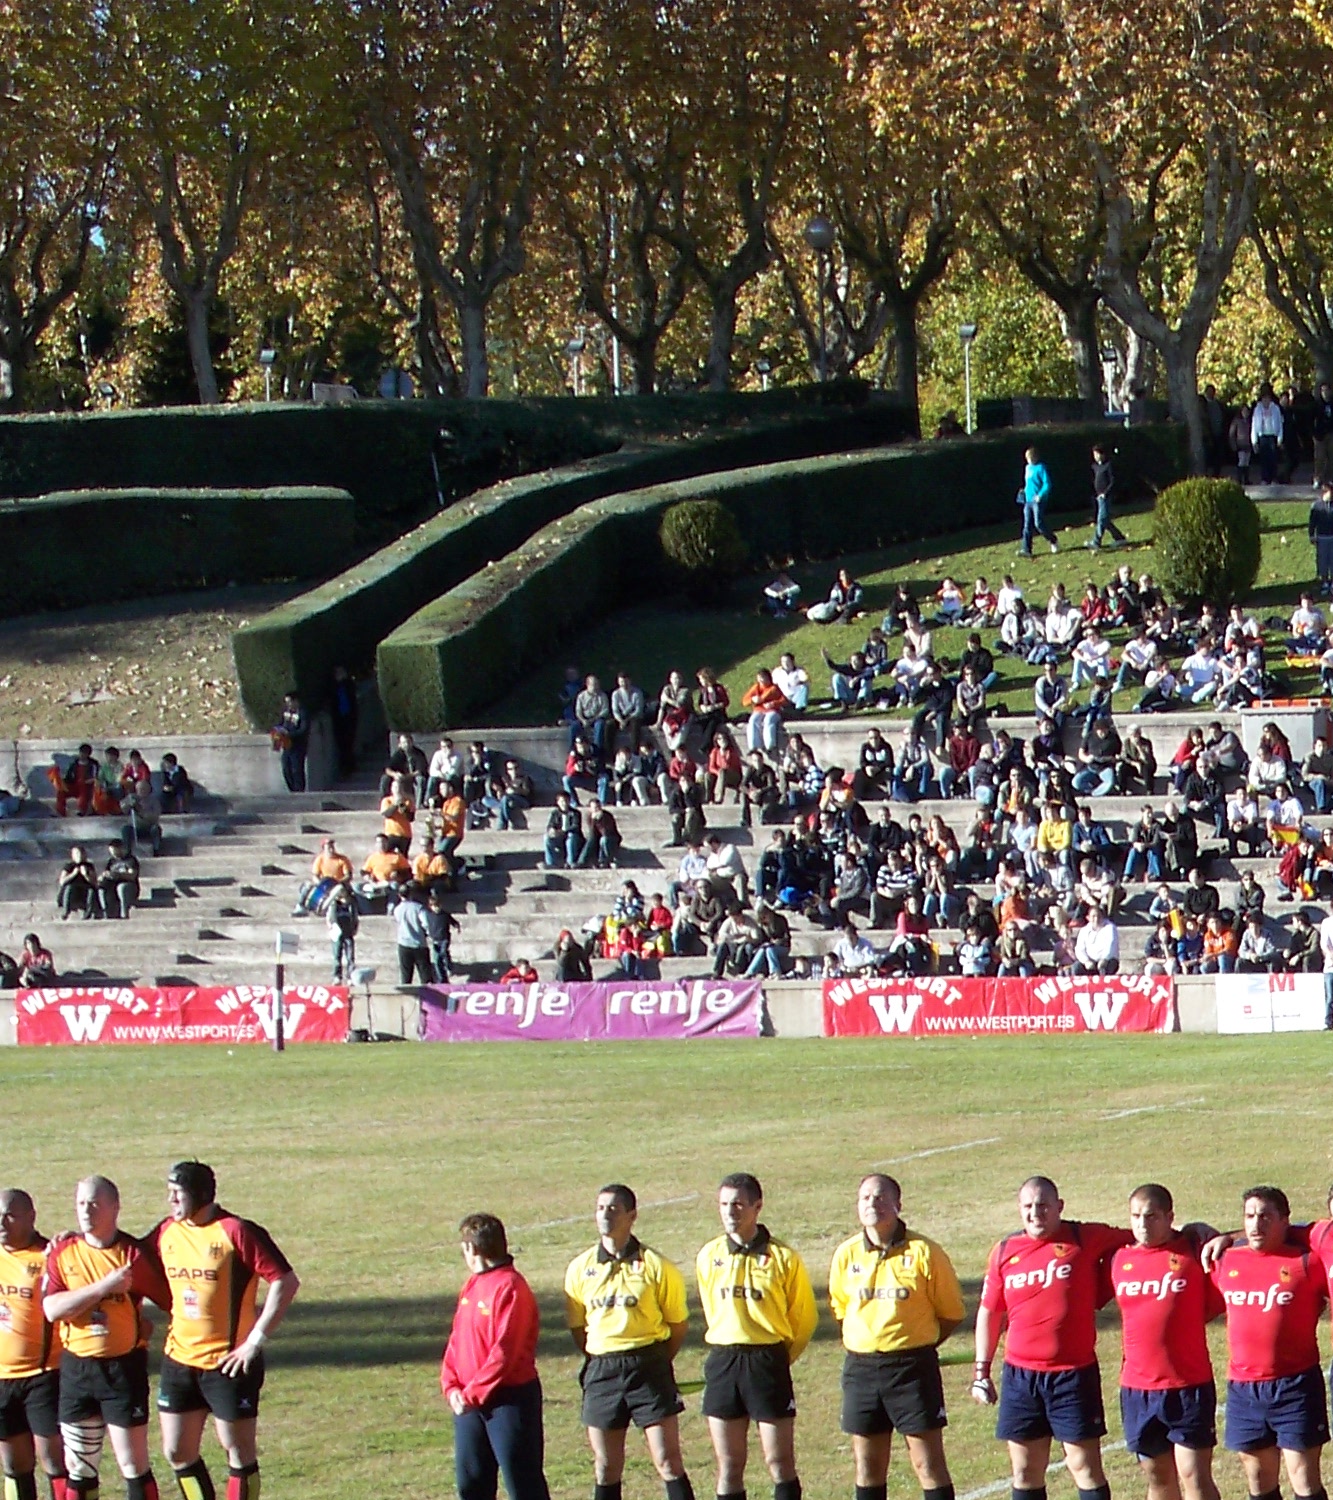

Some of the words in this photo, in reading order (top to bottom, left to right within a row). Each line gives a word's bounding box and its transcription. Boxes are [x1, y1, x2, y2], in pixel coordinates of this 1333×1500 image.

[449, 982, 570, 1029] renfe
[610, 979, 735, 1027] renfe
[868, 994, 923, 1033] W
[1073, 991, 1129, 1032] W
[59, 1004, 111, 1042] W
[925, 1015, 1075, 1030] WWW.WESTPORT.ES
[168, 1266, 218, 1281] CAPS
[1005, 1258, 1072, 1289] renfe
[1116, 1271, 1187, 1301] renfe
[590, 1294, 638, 1309] IVECO
[858, 1287, 910, 1301] IVECO
[1224, 1283, 1294, 1312] renfe
